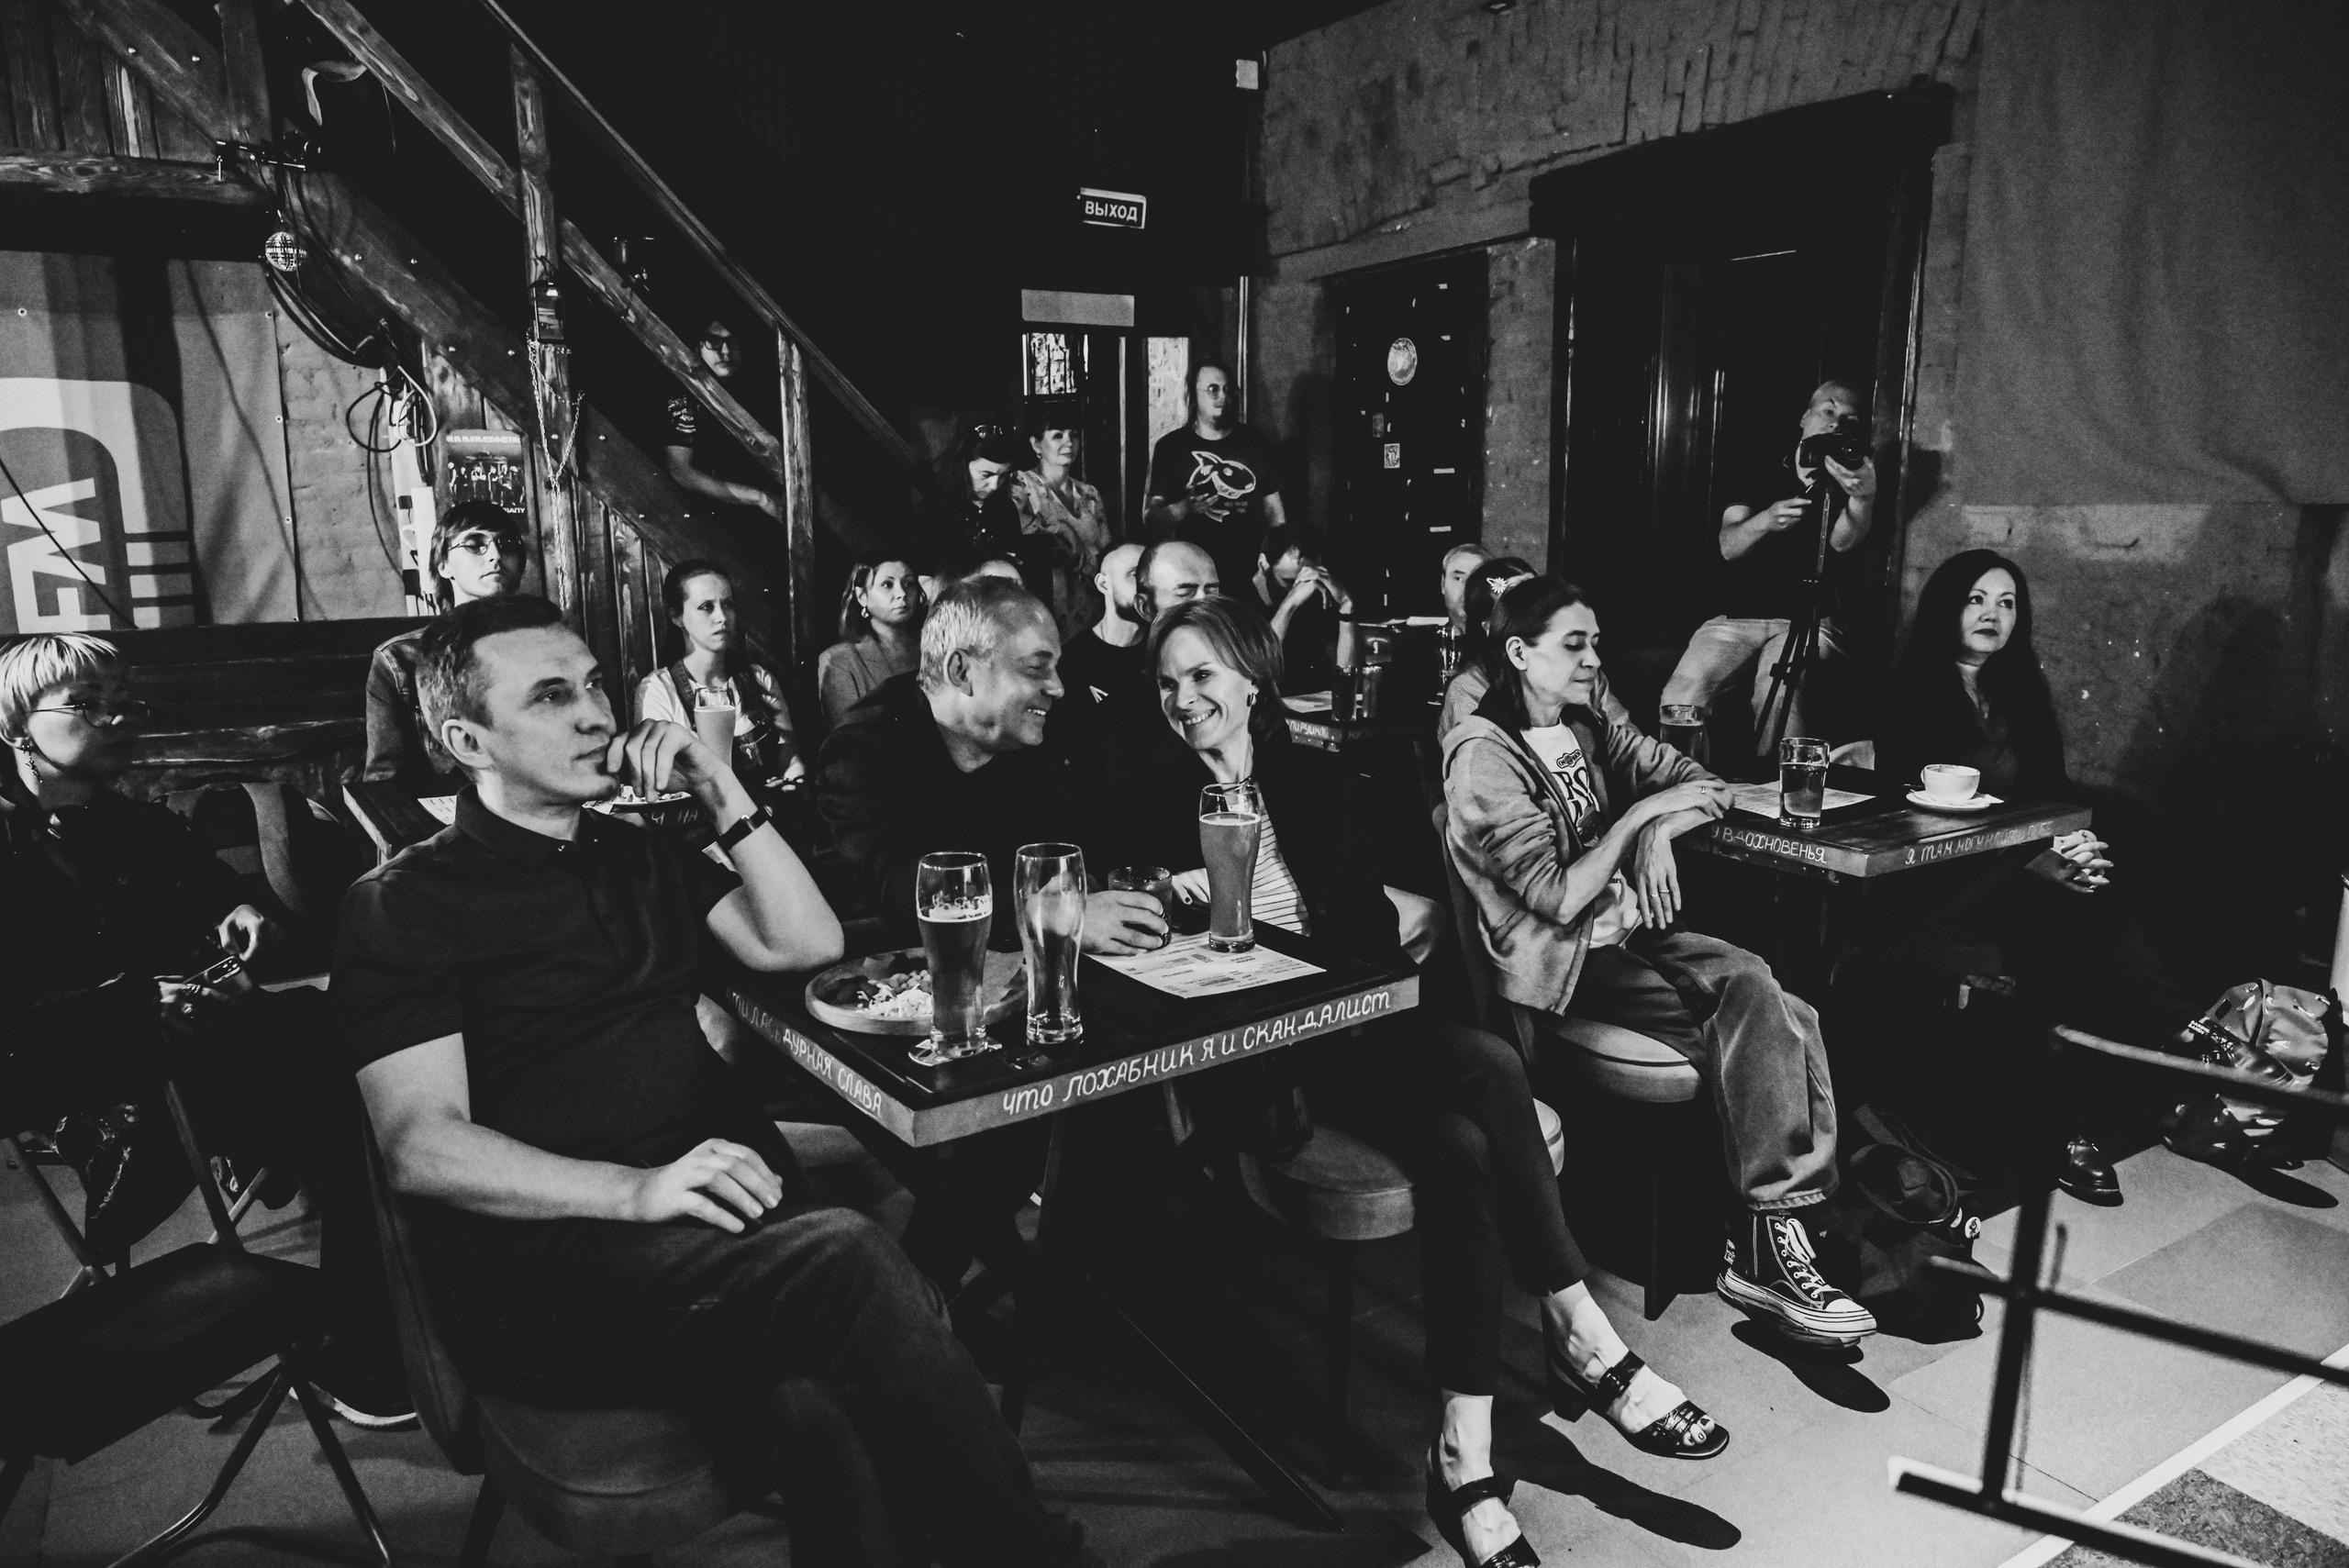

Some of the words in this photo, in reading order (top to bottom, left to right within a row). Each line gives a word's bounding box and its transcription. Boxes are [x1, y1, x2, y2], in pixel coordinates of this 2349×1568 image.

[1085, 200, 1138, 223] ВЫХОД
[1722, 827, 1827, 864] ВДОХНОВЕНЬЯ
[1905, 847, 1916, 865] Я
[1003, 1083, 1054, 1116] ЧТО
[1063, 1045, 1195, 1102] ПОХАБНИК
[1200, 1037, 1216, 1062] Я
[1221, 1035, 1237, 1057] И
[1242, 990, 1391, 1051] СКАНДАЛИСТ
[783, 1028, 832, 1080] ДУРНАЯ
[838, 1067, 883, 1118] СЛАВА
